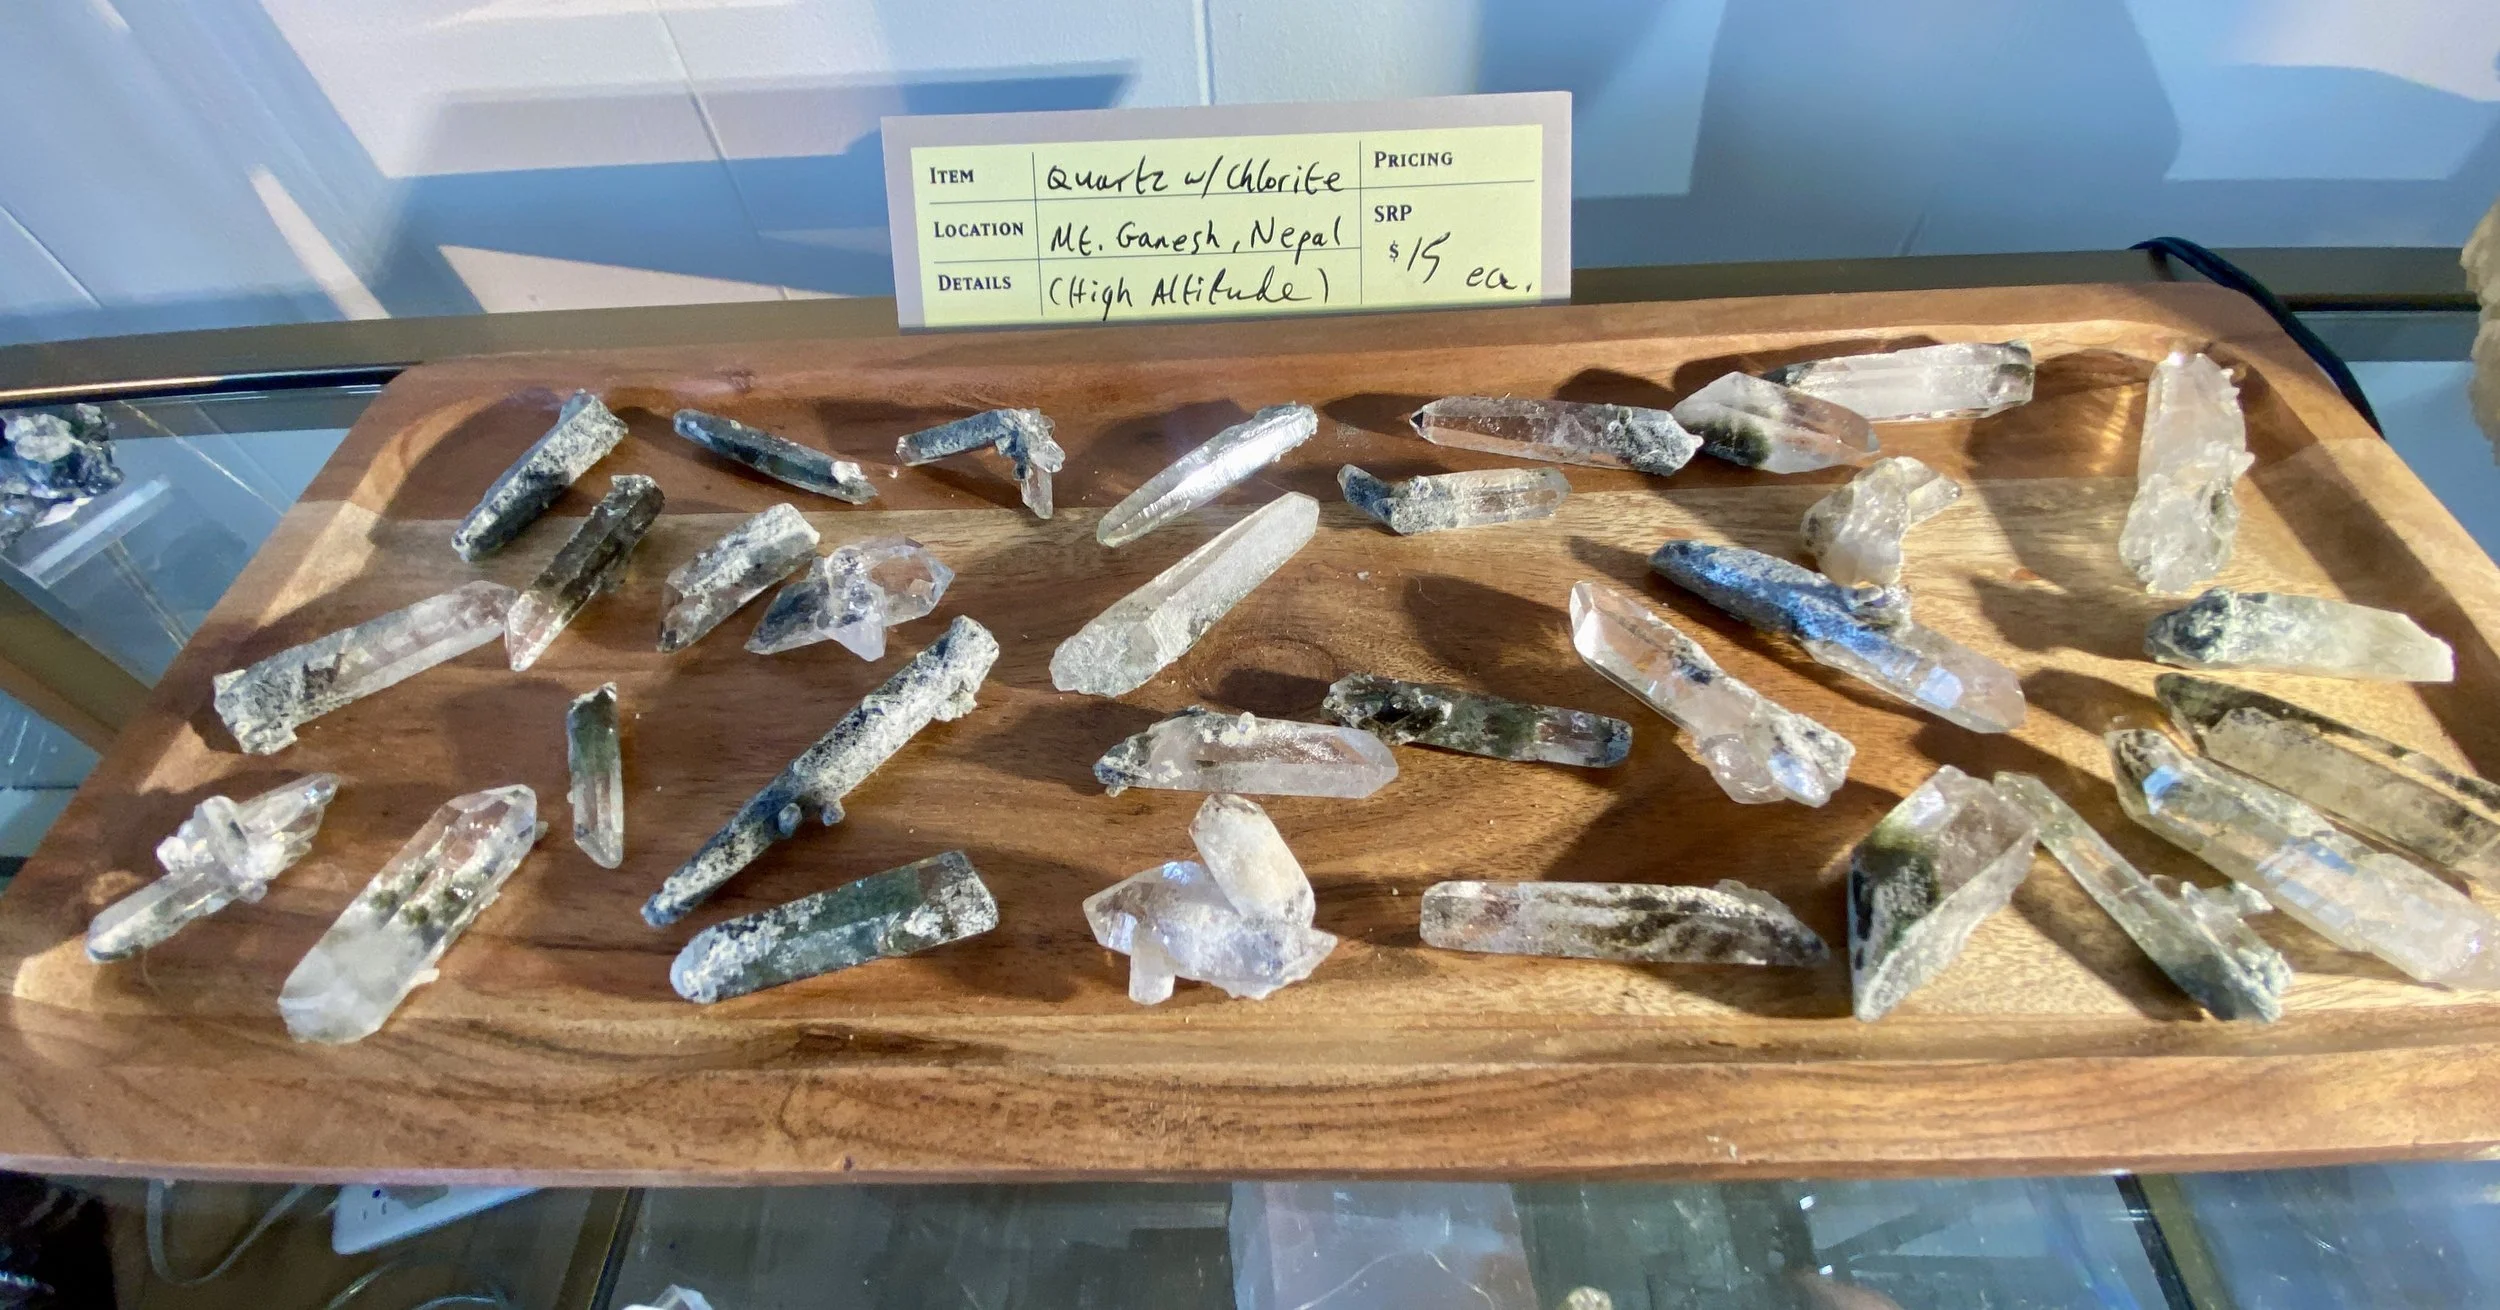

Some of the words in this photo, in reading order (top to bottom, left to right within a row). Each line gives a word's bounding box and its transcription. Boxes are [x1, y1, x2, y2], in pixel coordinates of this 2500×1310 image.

[1373, 150, 1454, 170] PRICING
[929, 165, 975, 186] ITEM
[1046, 155, 1169, 195] Quartz
[1373, 204, 1412, 224] SRP
[932, 220, 1024, 241] LOCATION
[1050, 223, 1103, 254] Mt.
[1251, 217, 1342, 264] Nepal
[936, 272, 1012, 292] DETAILS
[1048, 273, 1133, 321] (High
[1152, 265, 1331, 306] Altitude)
